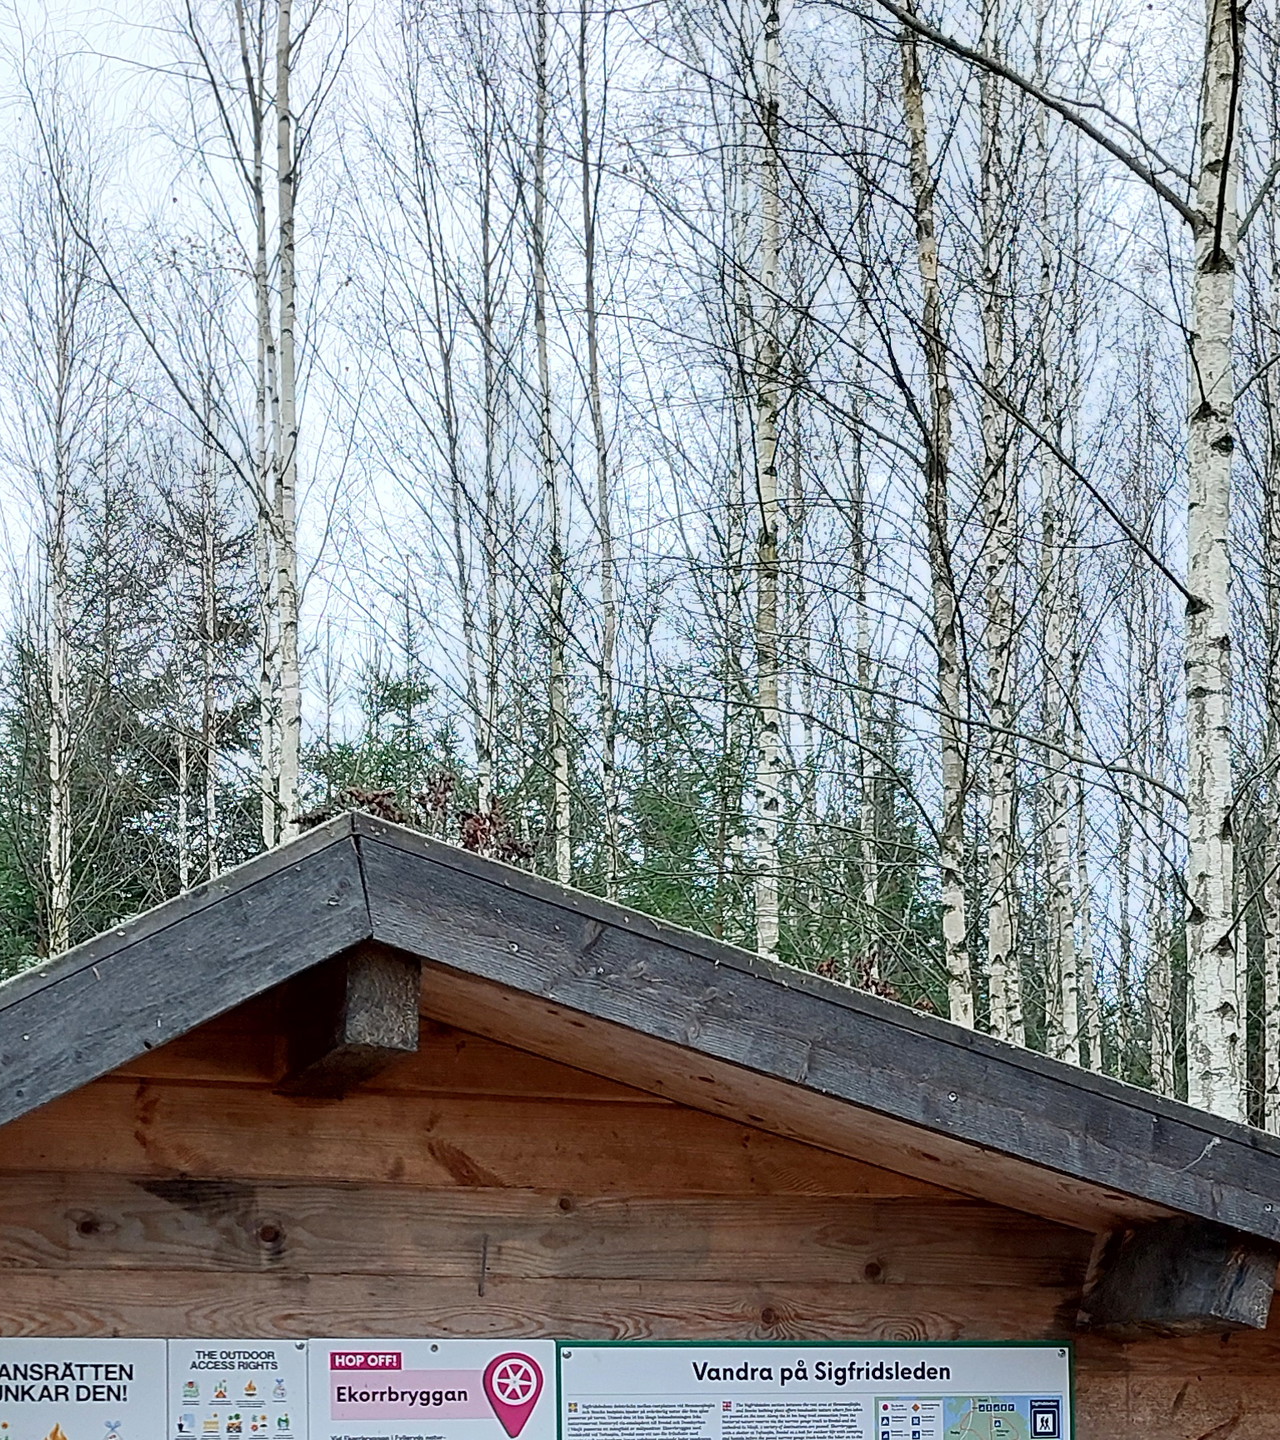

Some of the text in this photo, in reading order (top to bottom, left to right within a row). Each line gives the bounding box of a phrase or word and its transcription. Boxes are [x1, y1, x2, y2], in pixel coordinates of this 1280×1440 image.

[195, 1351, 275, 1359] THE OUTDOOR
[336, 1355, 396, 1366] HOP OFF!
[190, 1361, 278, 1370] ACCESS RIGHTS
[693, 1360, 950, 1386] Vandra på Sigfridsleden
[76, 1385, 127, 1401] DEN!
[337, 1386, 467, 1406] Ekorrbryggan
